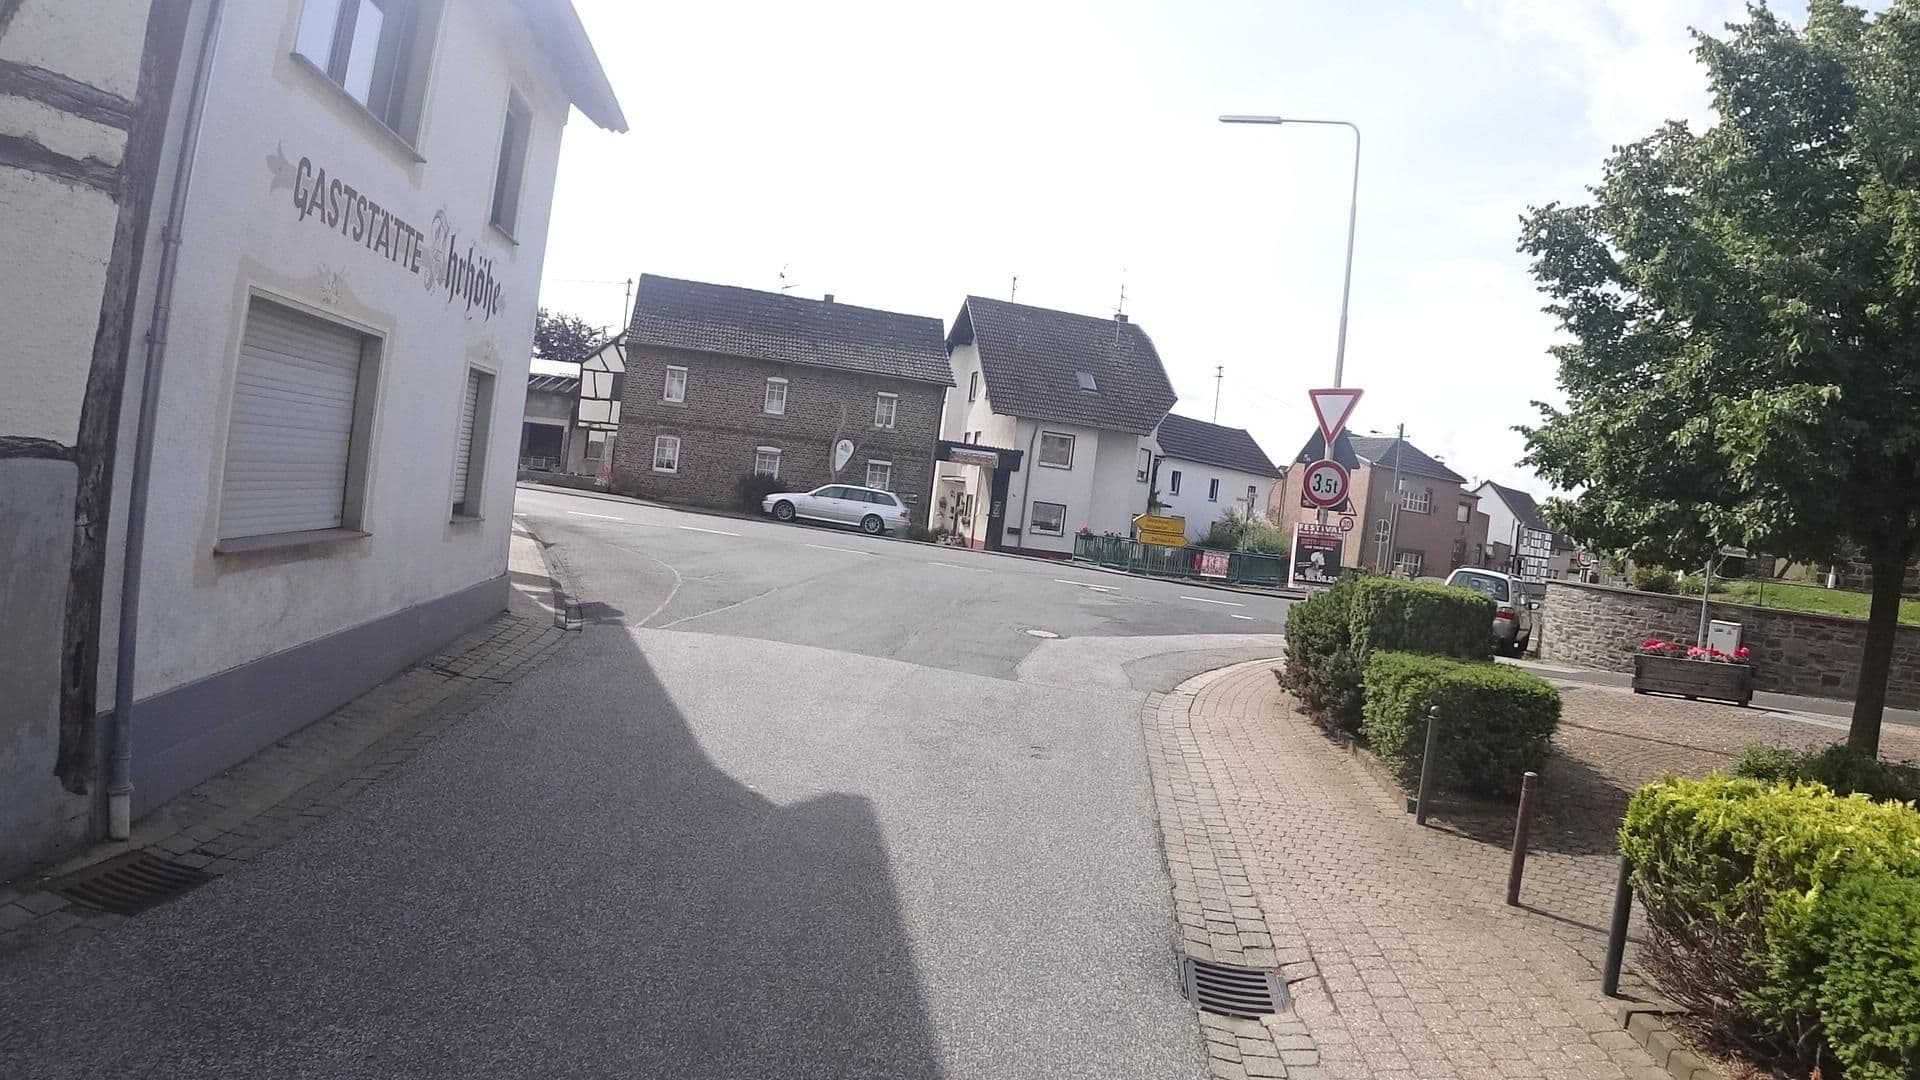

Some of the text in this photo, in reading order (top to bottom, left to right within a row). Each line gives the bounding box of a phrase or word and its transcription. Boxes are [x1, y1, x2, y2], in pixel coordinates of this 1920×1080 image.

[293, 156, 502, 323] GASTSTÄTTE Ahrhöhe
[1312, 473, 1338, 495] 3,5t
[1298, 523, 1342, 534] FESTIVAL
